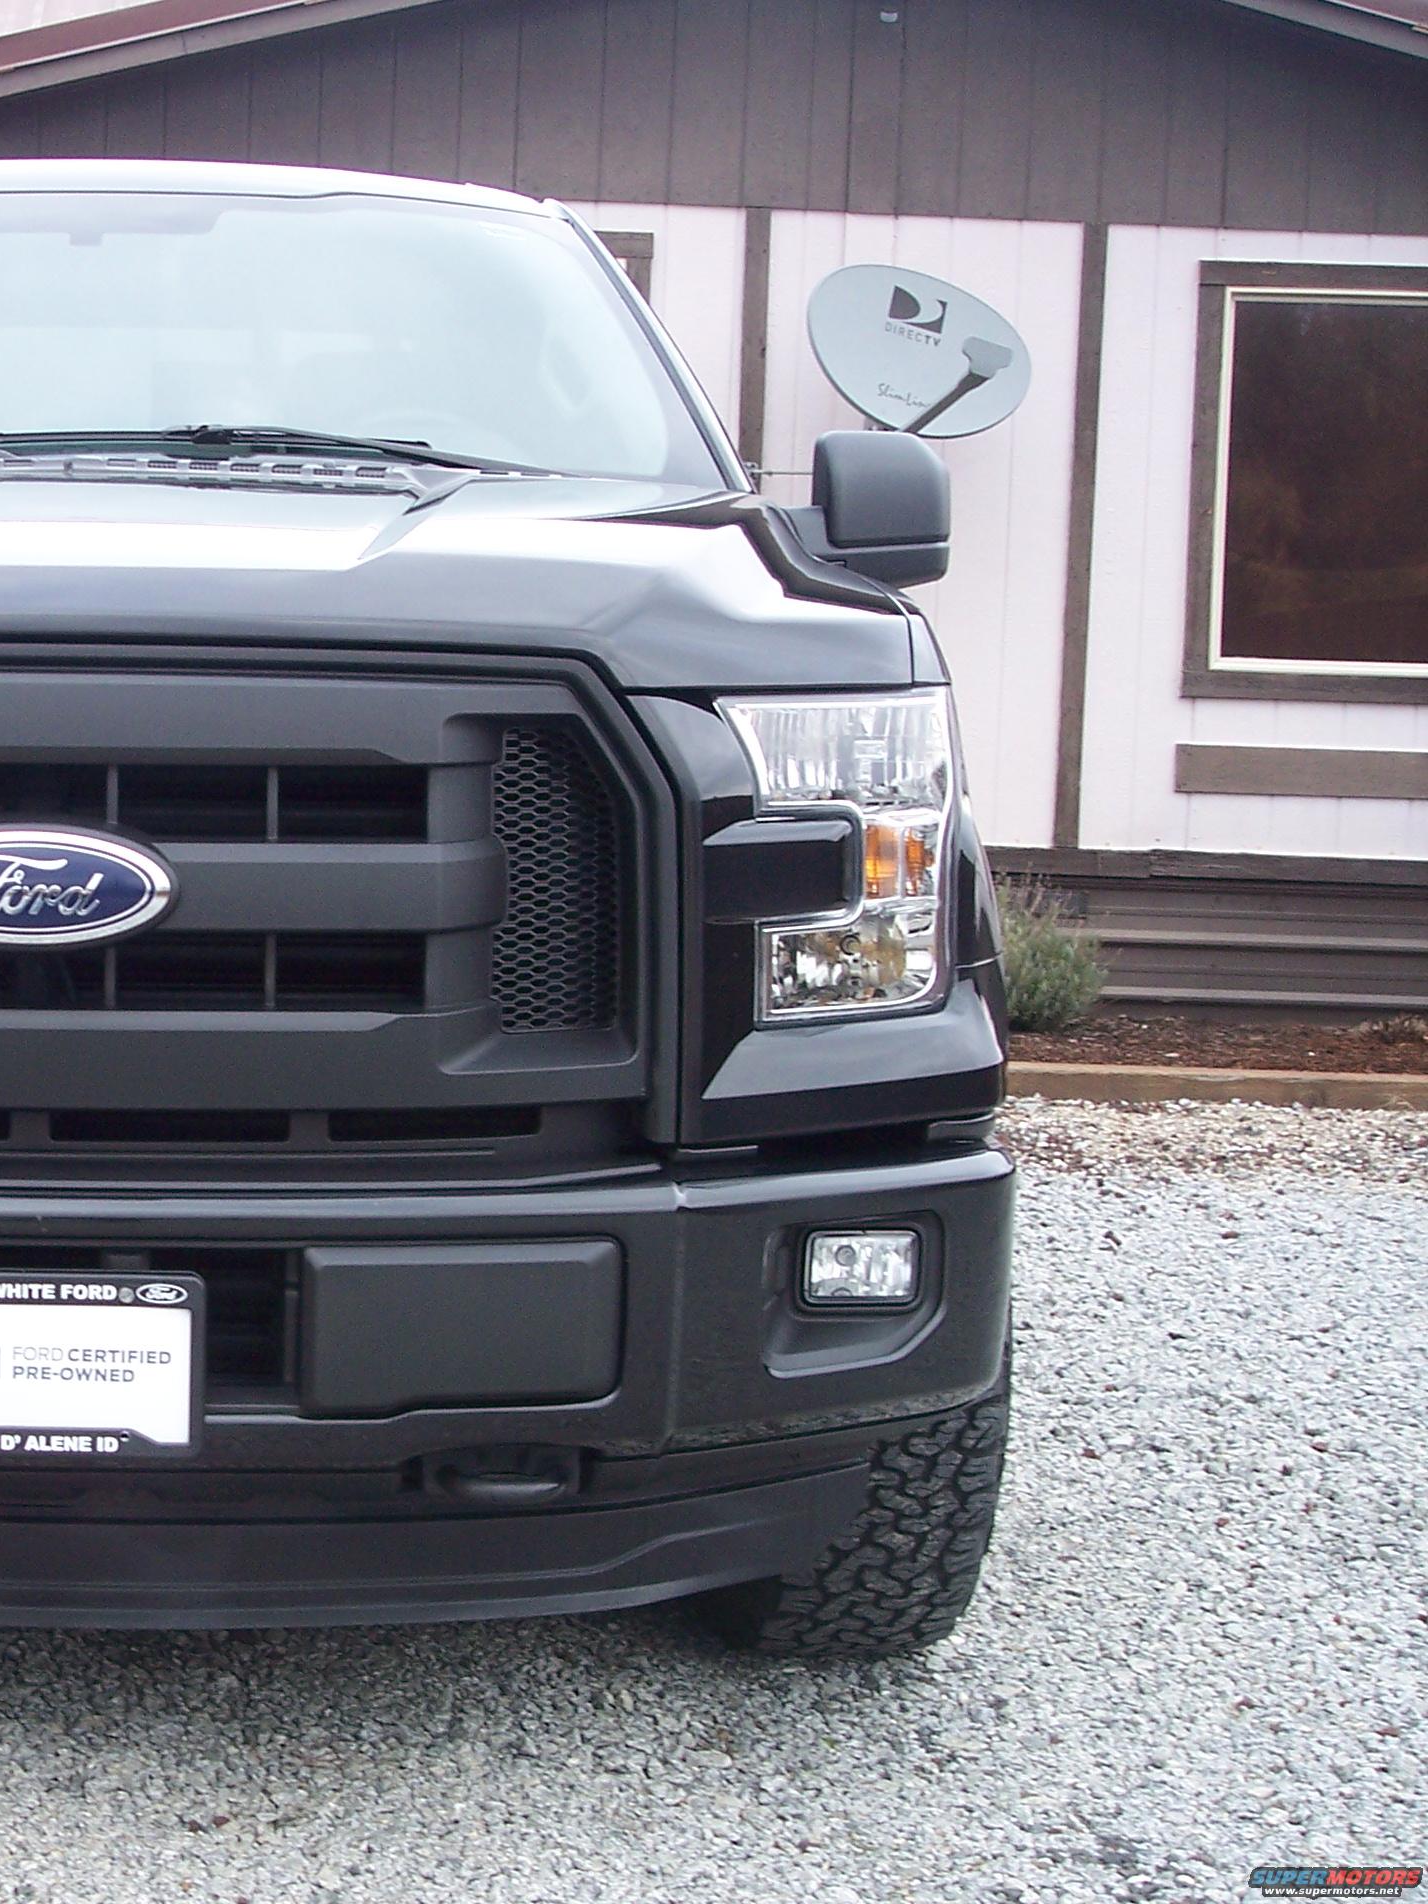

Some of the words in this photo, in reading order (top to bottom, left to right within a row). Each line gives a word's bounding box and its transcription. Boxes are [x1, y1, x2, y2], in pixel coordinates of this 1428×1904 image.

[884, 321, 942, 347] DIRECTV
[60, 1284, 118, 1301] FORD
[12, 1347, 64, 1362] FORD
[67, 1348, 172, 1365] CERTIFIED
[12, 1367, 135, 1383] PRE-OWNED
[25, 1434, 93, 1453] ALENE
[95, 1436, 120, 1454] ID
